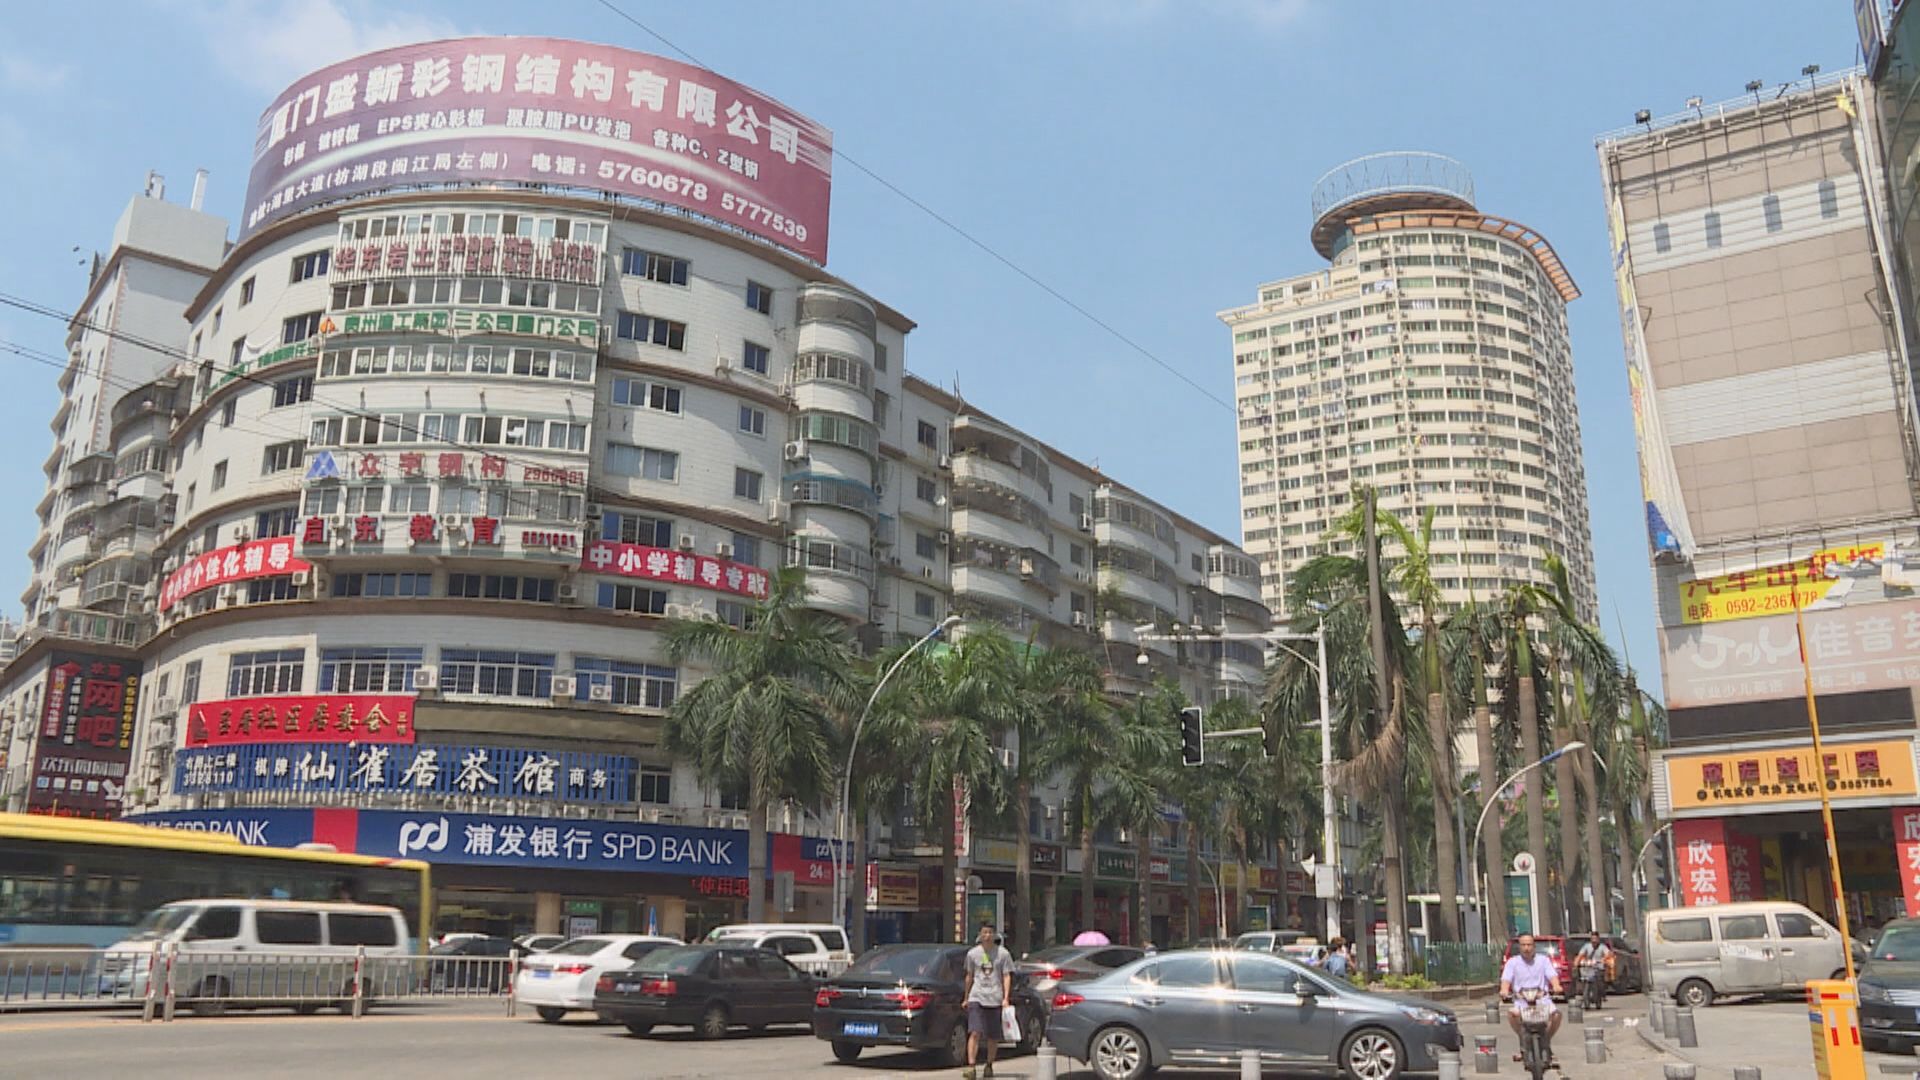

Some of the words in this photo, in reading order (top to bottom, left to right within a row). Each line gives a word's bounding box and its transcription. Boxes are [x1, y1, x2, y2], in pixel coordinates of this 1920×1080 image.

[598, 161, 708, 200] 5760678
[721, 193, 807, 241] 5777539
[304, 514, 498, 545] 启东教育
[78, 679, 122, 747] 网吧
[255, 757, 289, 777] 棋牌
[299, 745, 561, 794] 仙雀居茶馆
[569, 767, 608, 789] 商务
[463, 823, 594, 861] 浦发银行
[601, 832, 656, 861] SPD
[661, 837, 733, 865] BANK
